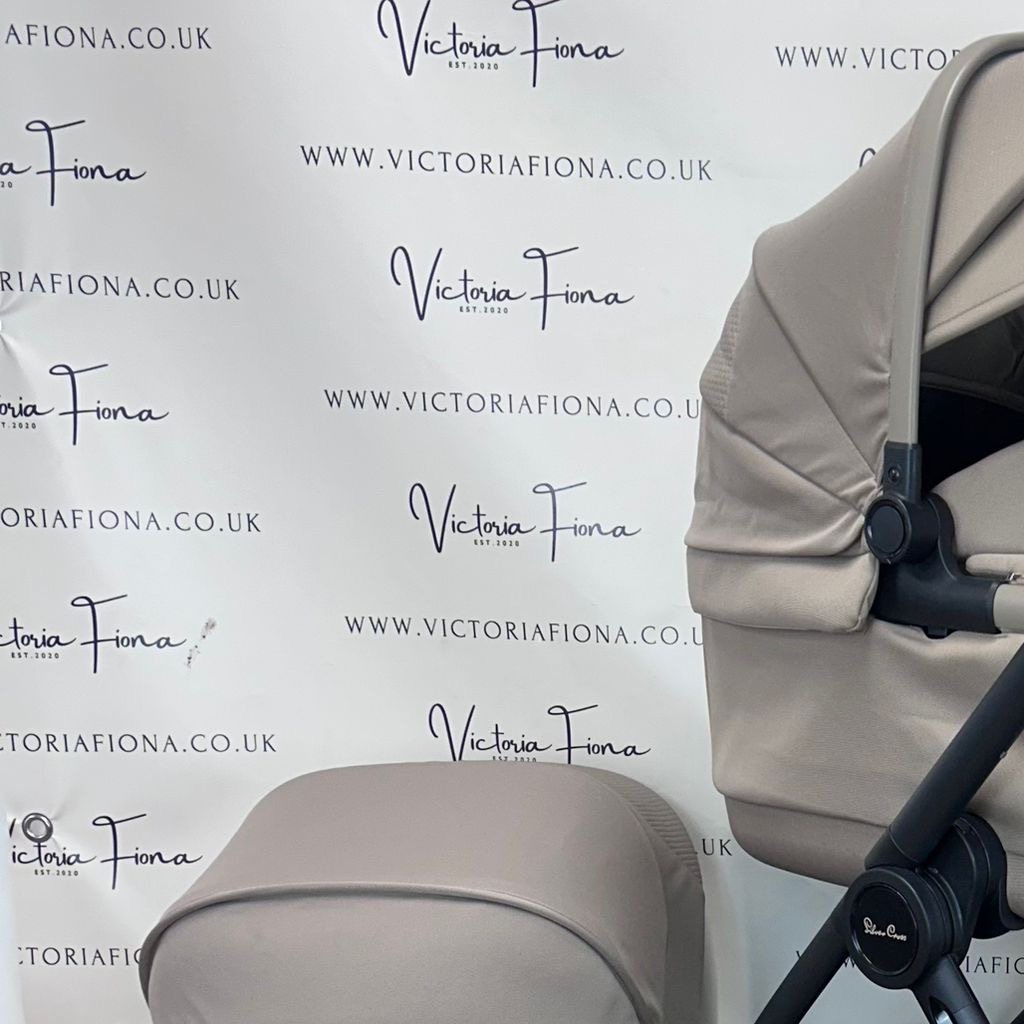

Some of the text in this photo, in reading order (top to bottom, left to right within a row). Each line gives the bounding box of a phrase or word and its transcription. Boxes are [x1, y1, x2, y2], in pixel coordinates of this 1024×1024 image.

[5, 24, 212, 50] AFIONA.CO.UK
[377, 0, 624, 87] Victoria Fiona
[775, 46, 960, 71] WWW.VICTO
[26, 120, 146, 206] Fiona
[300, 145, 713, 181] WWW.VICTORIAFIONA.CO.UK
[391, 246, 635, 331] Victoria Fiona
[49, 364, 170, 446] Fiona
[324, 389, 700, 419] WWW.VICTORIAFIONA.CO.U
[1, 507, 261, 532] ORIAFIONA.CO.UK
[409, 482, 642, 562] Victoria Fiona
[71, 595, 187, 674] Fiona
[344, 616, 703, 646] WWW.VICTORIAFIONA.CO.U
[0, 733, 276, 753] TORIAFIONA.CO.UK
[428, 703, 651, 764] Victoria Fiona
[9, 813, 203, 890] ictoria Fiona
